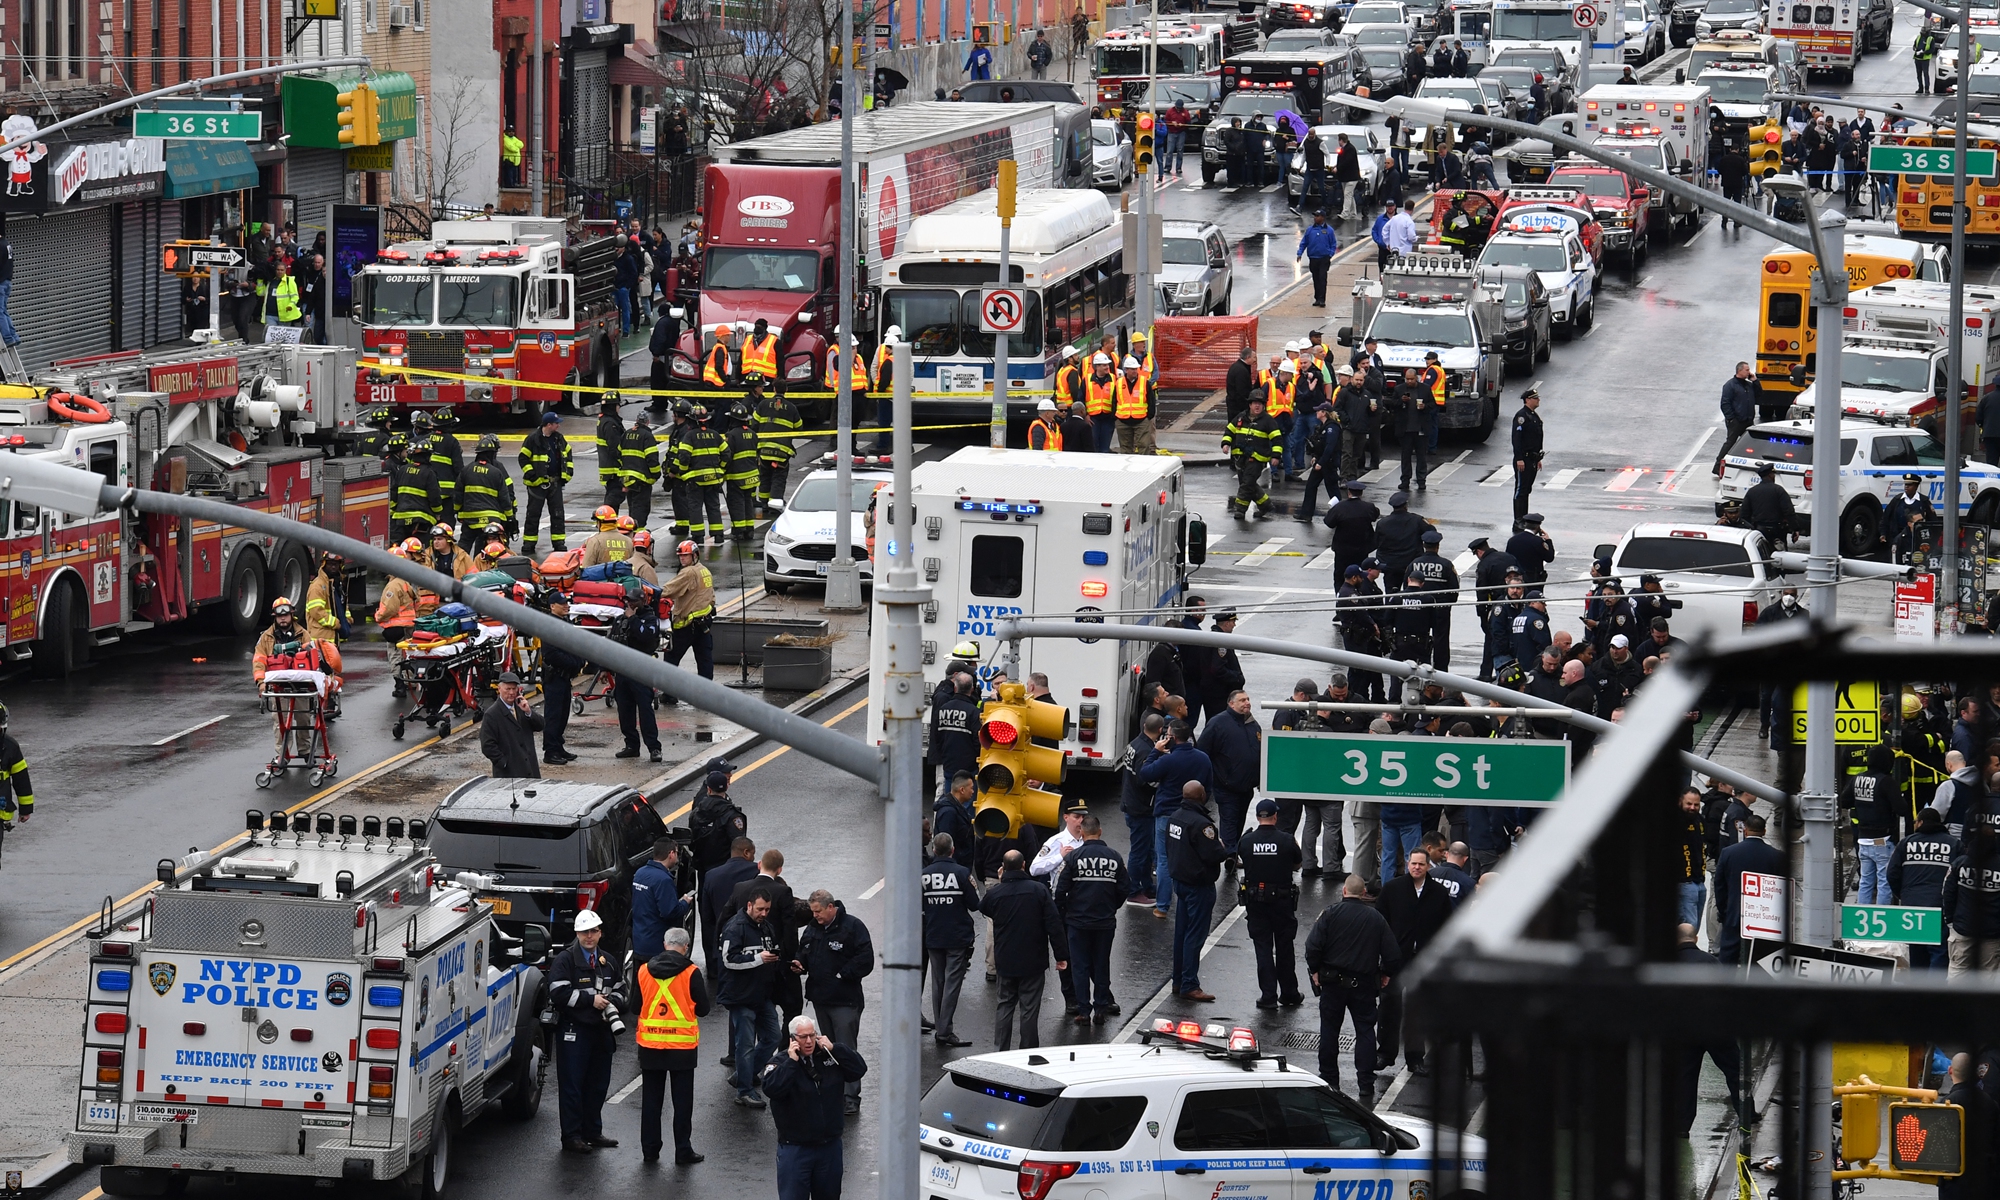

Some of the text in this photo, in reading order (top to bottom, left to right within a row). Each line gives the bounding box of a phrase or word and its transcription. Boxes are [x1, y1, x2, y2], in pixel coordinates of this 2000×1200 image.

[167, 117, 229, 134] 36 St
[87, 141, 120, 180] DELI
[126, 139, 166, 175] GRILL
[356, 156, 385, 168] NOODLE
[1900, 152, 1950, 169] 36 S
[61, 151, 87, 198] KING
[747, 201, 783, 210] JBS
[741, 217, 788, 228] CARRIERS
[197, 252, 213, 260] ONE
[443, 275, 480, 283] AMERICA
[1848, 267, 1867, 281] BUS
[1963, 328, 1983, 337] 1345
[154, 365, 236, 393] LADDER 114 TALLY HO
[371, 386, 396, 402] 201
[406, 467, 420, 475] FDNY
[473, 465, 489, 474] FDNY
[963, 502, 1036, 513] S THE LA
[98, 532, 113, 559] 114
[1413, 562, 1443, 572] NYPD
[1897, 582, 1917, 590] Anytime
[968, 604, 1022, 619] NYPD
[958, 621, 996, 636] POL
[939, 709, 967, 720] NYPD
[939, 719, 966, 727] POLICE
[1796, 717, 1873, 734] SOOL
[1340, 749, 1491, 790] 35 St
[1854, 775, 1876, 788] NYPD
[1854, 787, 1875, 798] POLICE
[1169, 823, 1182, 836] NYPD
[1253, 843, 1278, 852] NYPD
[1906, 841, 1951, 854] NYPD
[1077, 857, 1118, 870] NYPD
[1906, 854, 1950, 863] POLICE
[1079, 869, 1117, 878] POLICE
[921, 873, 959, 889] PBA
[1762, 885, 1782, 894] Loading
[1762, 892, 1774, 900] Only
[1760, 904, 1769, 912] 7pm
[1745, 911, 1781, 922] Except Sunday
[1853, 909, 1926, 938] 35 ST
[436, 941, 466, 989] POLICE
[200, 959, 301, 985] NYPD
[328, 974, 350, 983] POLICE
[1829, 964, 1874, 985] WAY
[182, 983, 318, 1010] POLICE
[176, 1050, 318, 1072] EMERGENCY SERVICE
[160, 1074, 334, 1090] KEEP BACK 200 FEET
[89, 1107, 116, 1119] 5751
[137, 1106, 197, 1116] $10,000 REWARD
[964, 1141, 1011, 1160] POLICE
[1120, 1161, 1134, 1173] ESU
[1137, 1160, 1151, 1171] K-9
